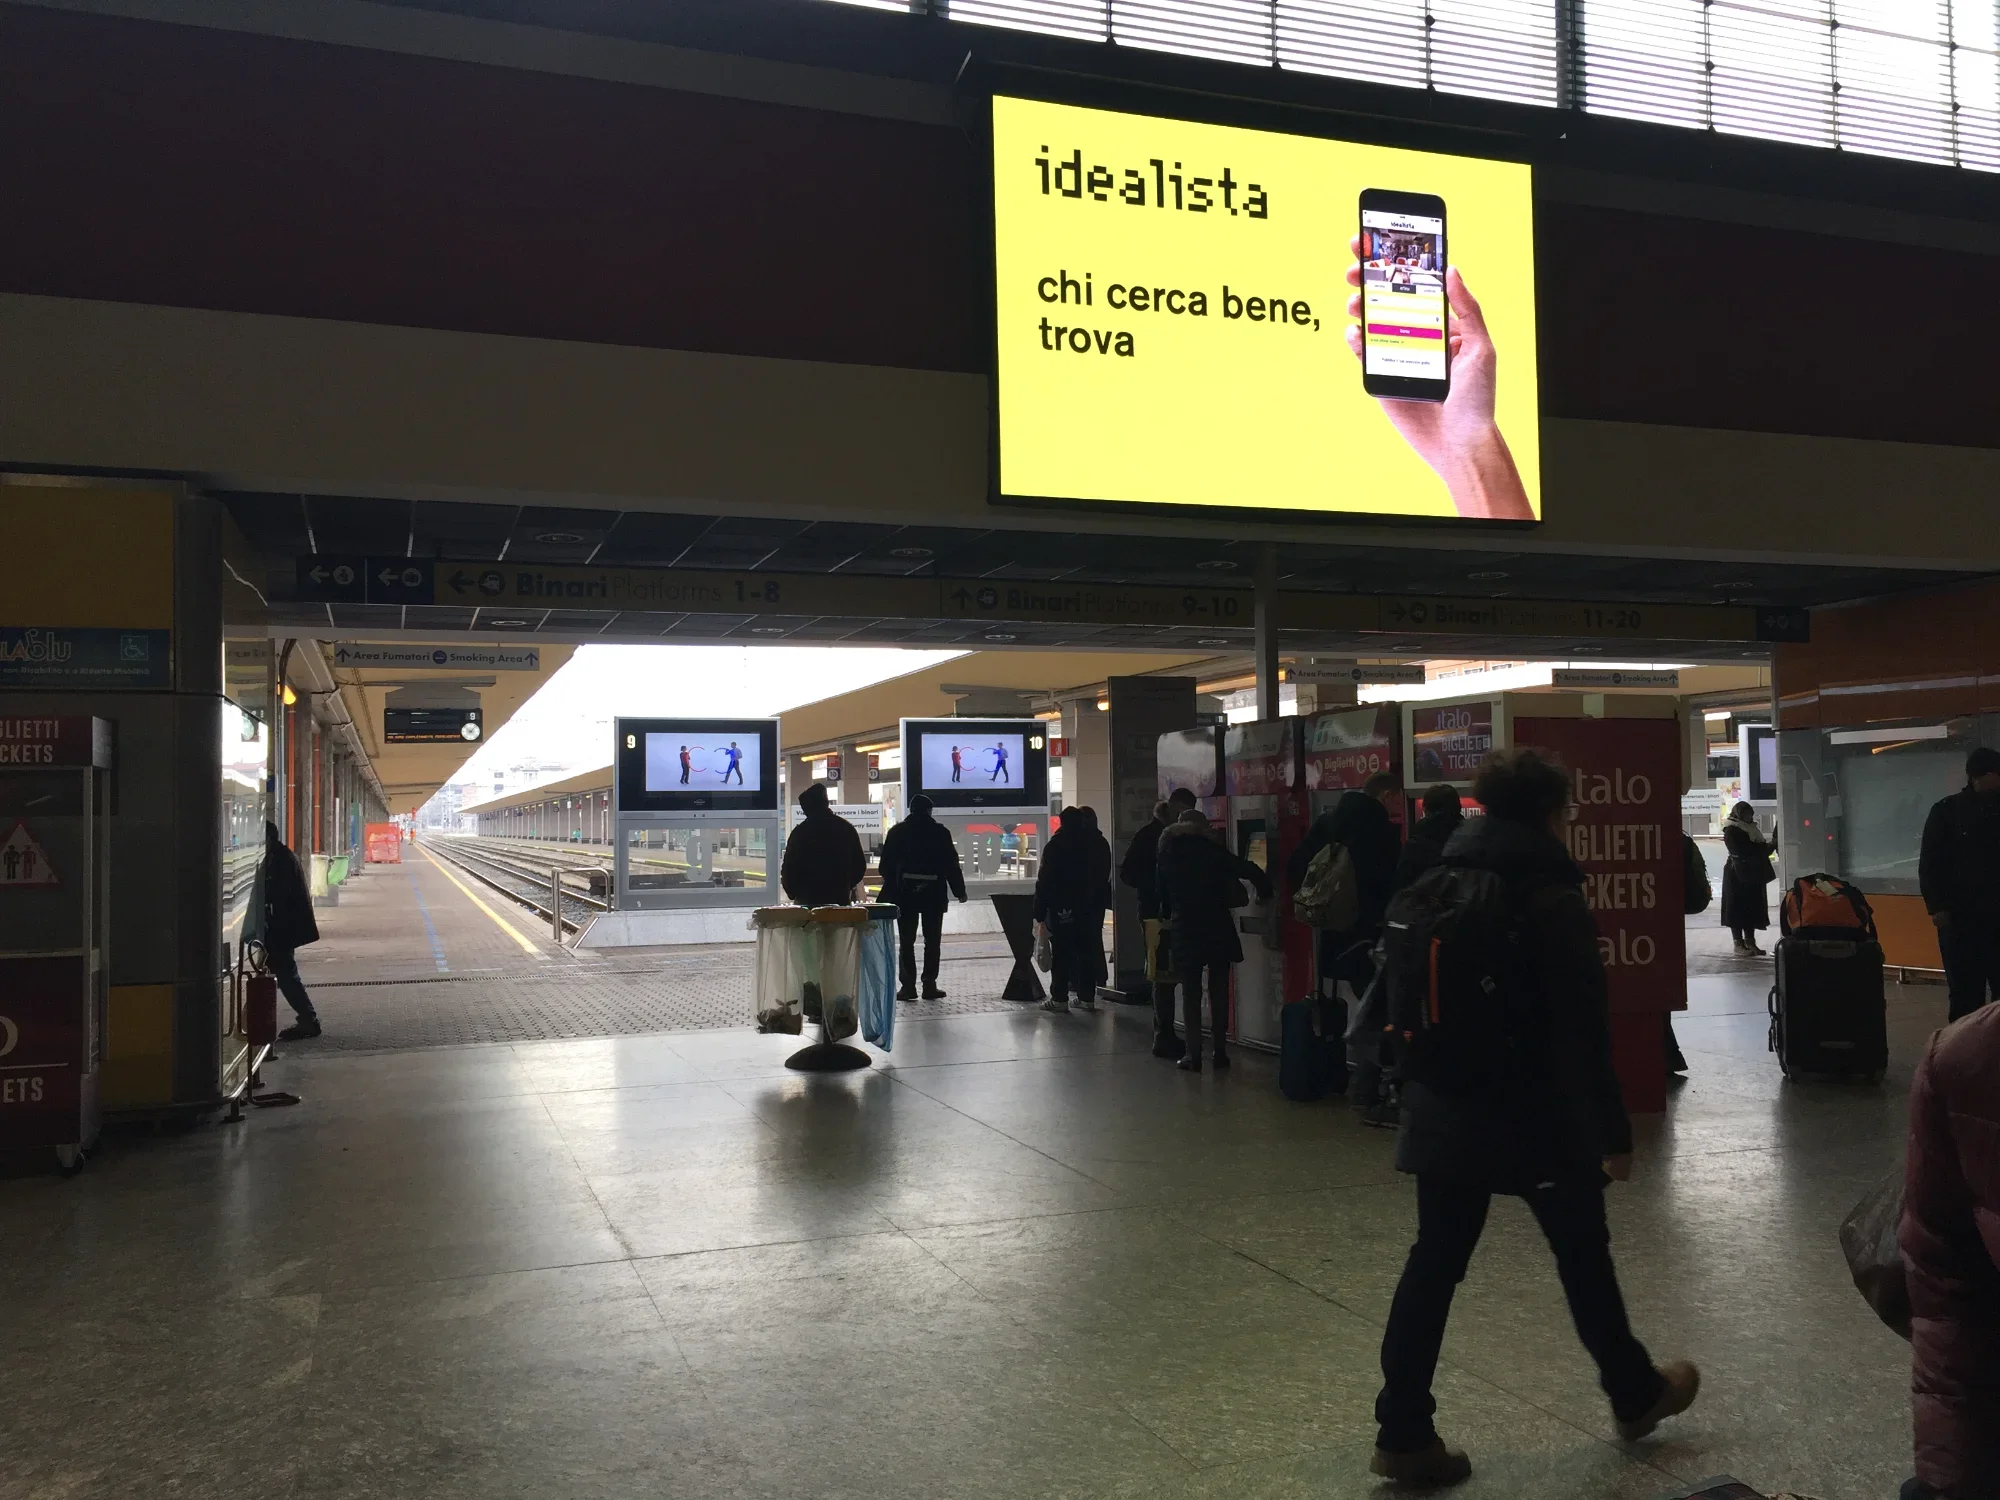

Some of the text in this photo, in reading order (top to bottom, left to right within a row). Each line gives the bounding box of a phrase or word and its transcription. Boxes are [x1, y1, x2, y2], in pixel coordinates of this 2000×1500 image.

[1035, 144, 1268, 219] idealista
[1037, 269, 1321, 332] chi cerca bene,
[1038, 317, 1134, 357] trova
[516, 571, 781, 603] Binari Platforms 1-8
[1007, 588, 1080, 612] Binari
[1180, 595, 1239, 617] 9-10
[1435, 604, 1497, 625] Binari
[353, 651, 430, 661] Area Fumatori
[450, 653, 523, 664] Smoking Area
[470, 712, 476, 720] 9
[627, 735, 636, 748] 9
[1029, 736, 1043, 750] 10
[1324, 756, 1355, 772] Biglietti
[1448, 753, 1484, 769] TICKET
[1575, 767, 1652, 805] talo
[1565, 824, 1662, 862] IGLIETTI
[1581, 872, 1657, 911] CKETS
[1597, 928, 1656, 967] alo
